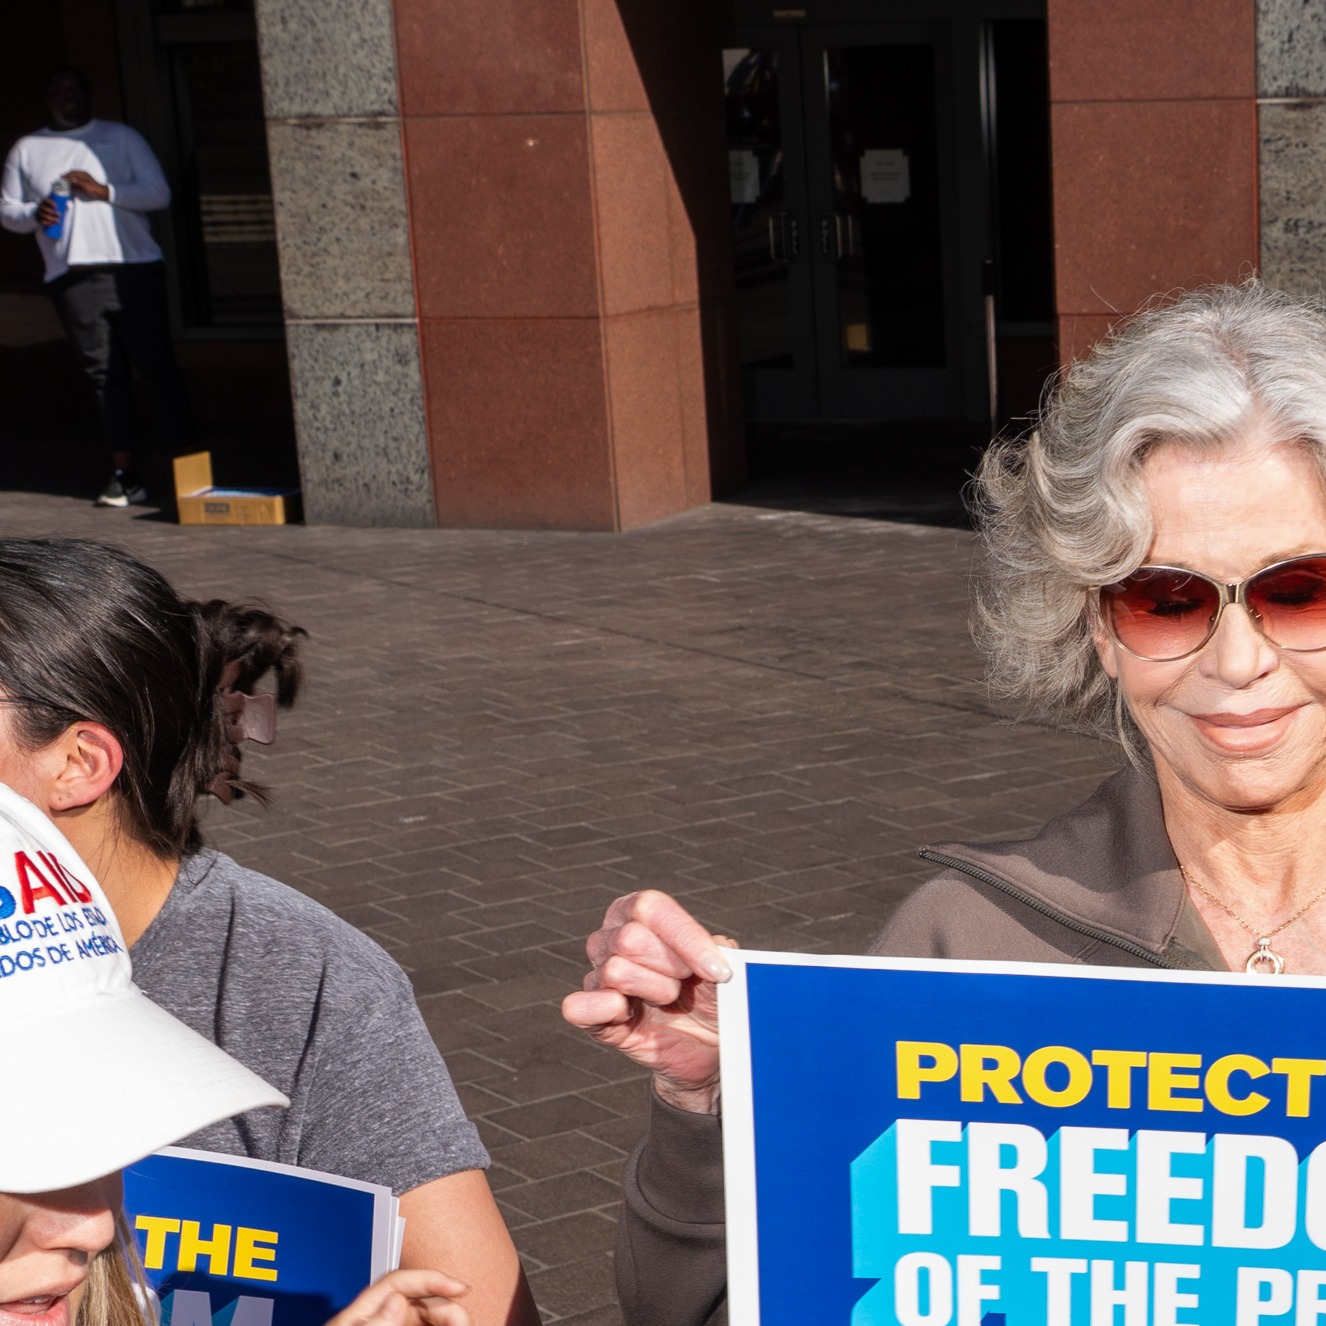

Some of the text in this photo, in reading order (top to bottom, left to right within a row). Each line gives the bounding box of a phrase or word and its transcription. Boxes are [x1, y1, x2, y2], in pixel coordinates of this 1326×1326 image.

[31, 916, 59, 938] DE
[56, 911, 85, 932] LOS
[46, 943, 74, 964] DE
[896, 1040, 1326, 1118] PROTECT
[134, 1215, 279, 1282] THE
